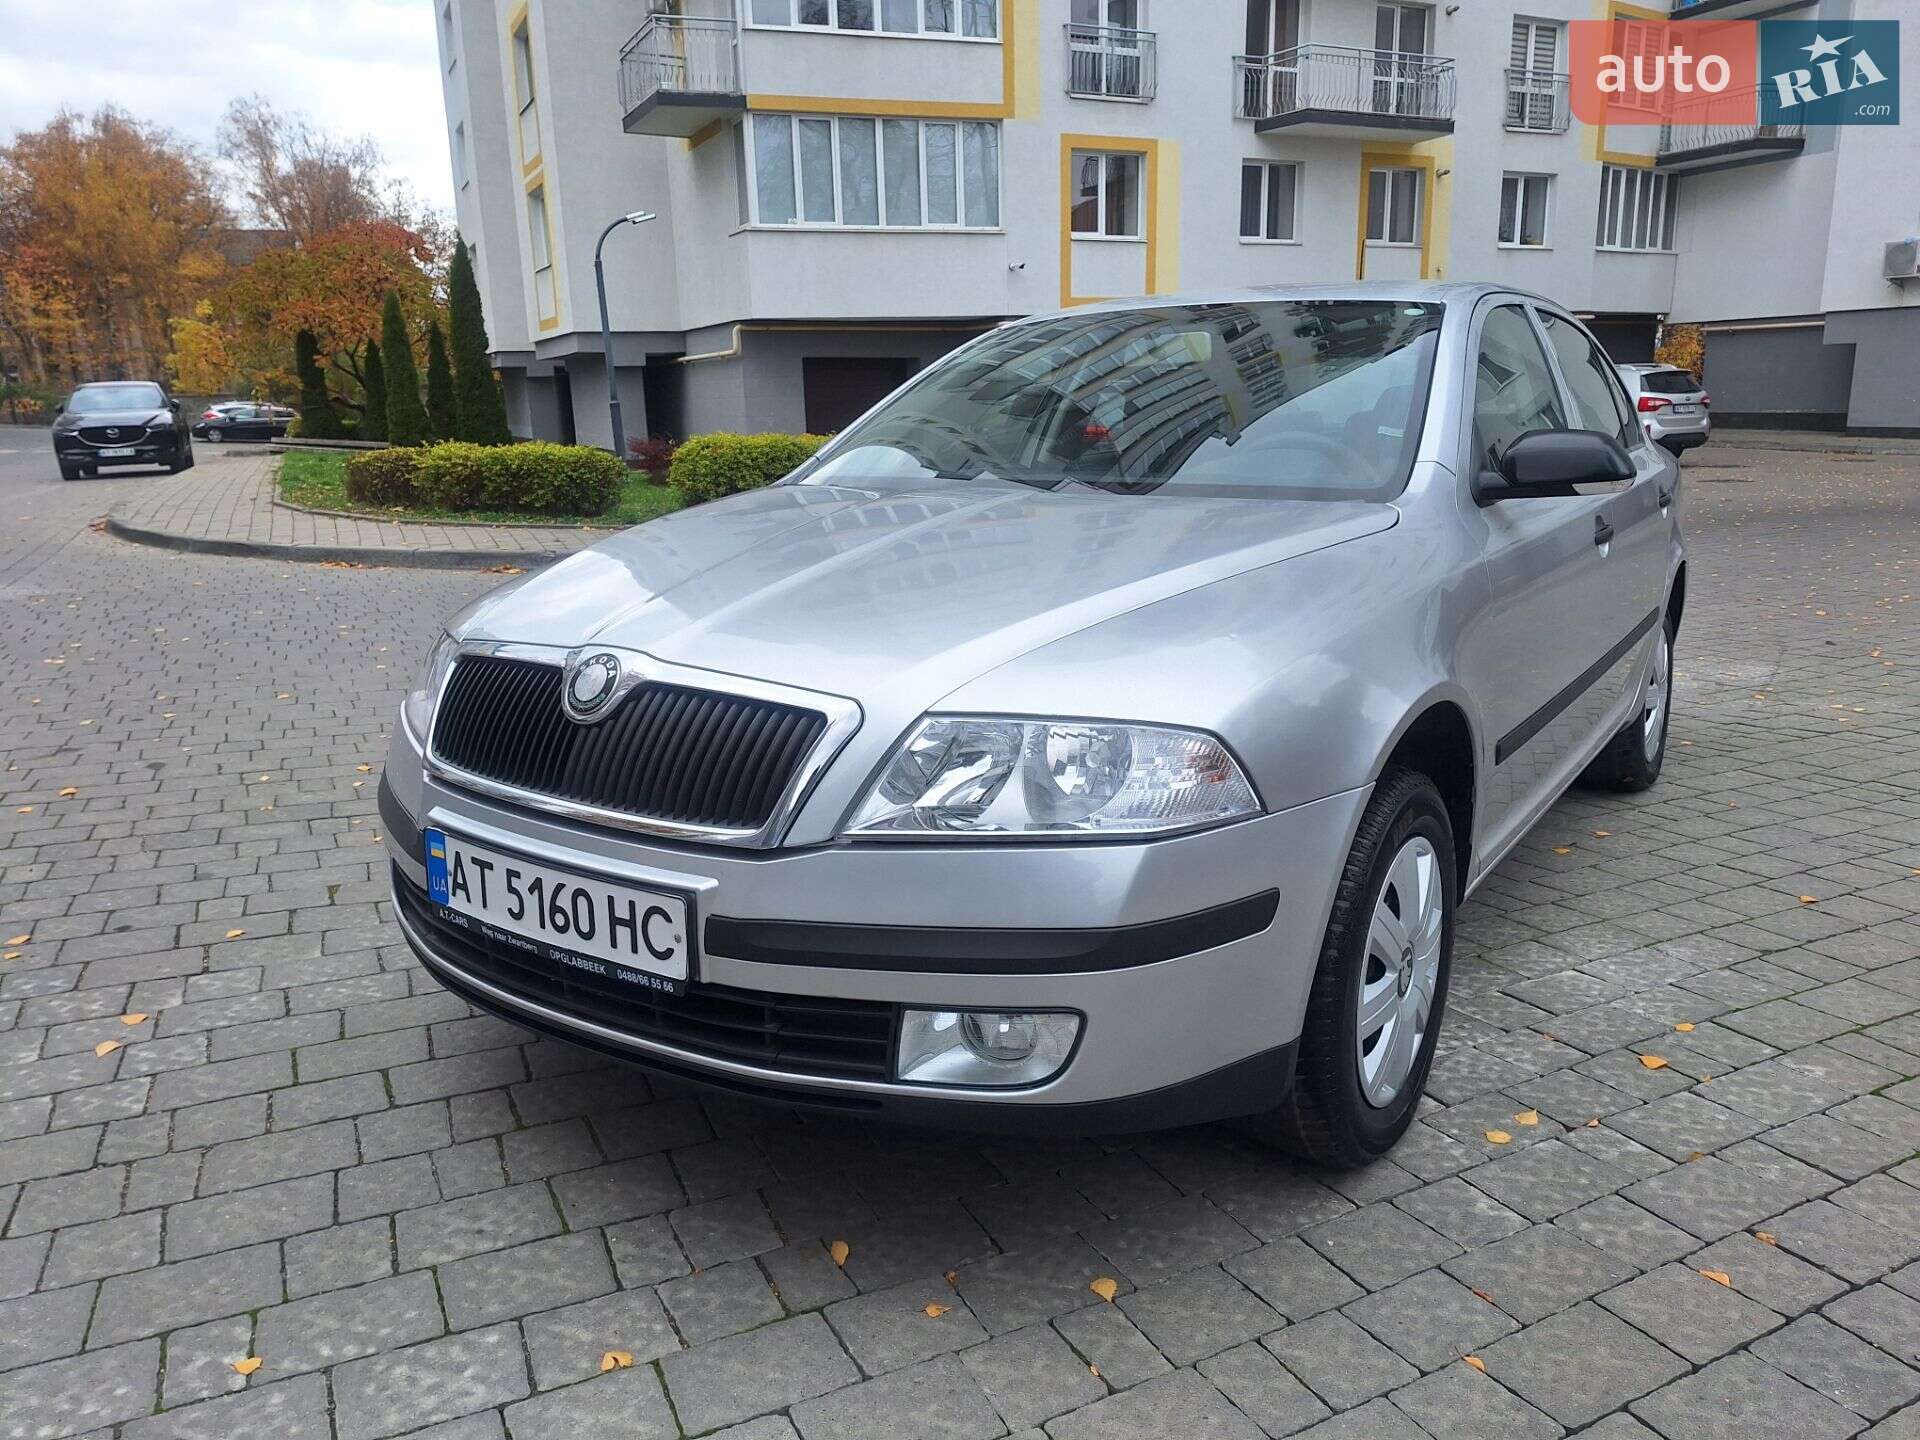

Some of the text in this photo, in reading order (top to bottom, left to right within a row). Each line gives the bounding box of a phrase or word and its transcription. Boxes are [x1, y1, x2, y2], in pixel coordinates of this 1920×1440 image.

[433, 876, 447, 893] UA
[451, 851, 675, 961] AT 5160 HC
[549, 949, 607, 976] OPGLABBEEK
